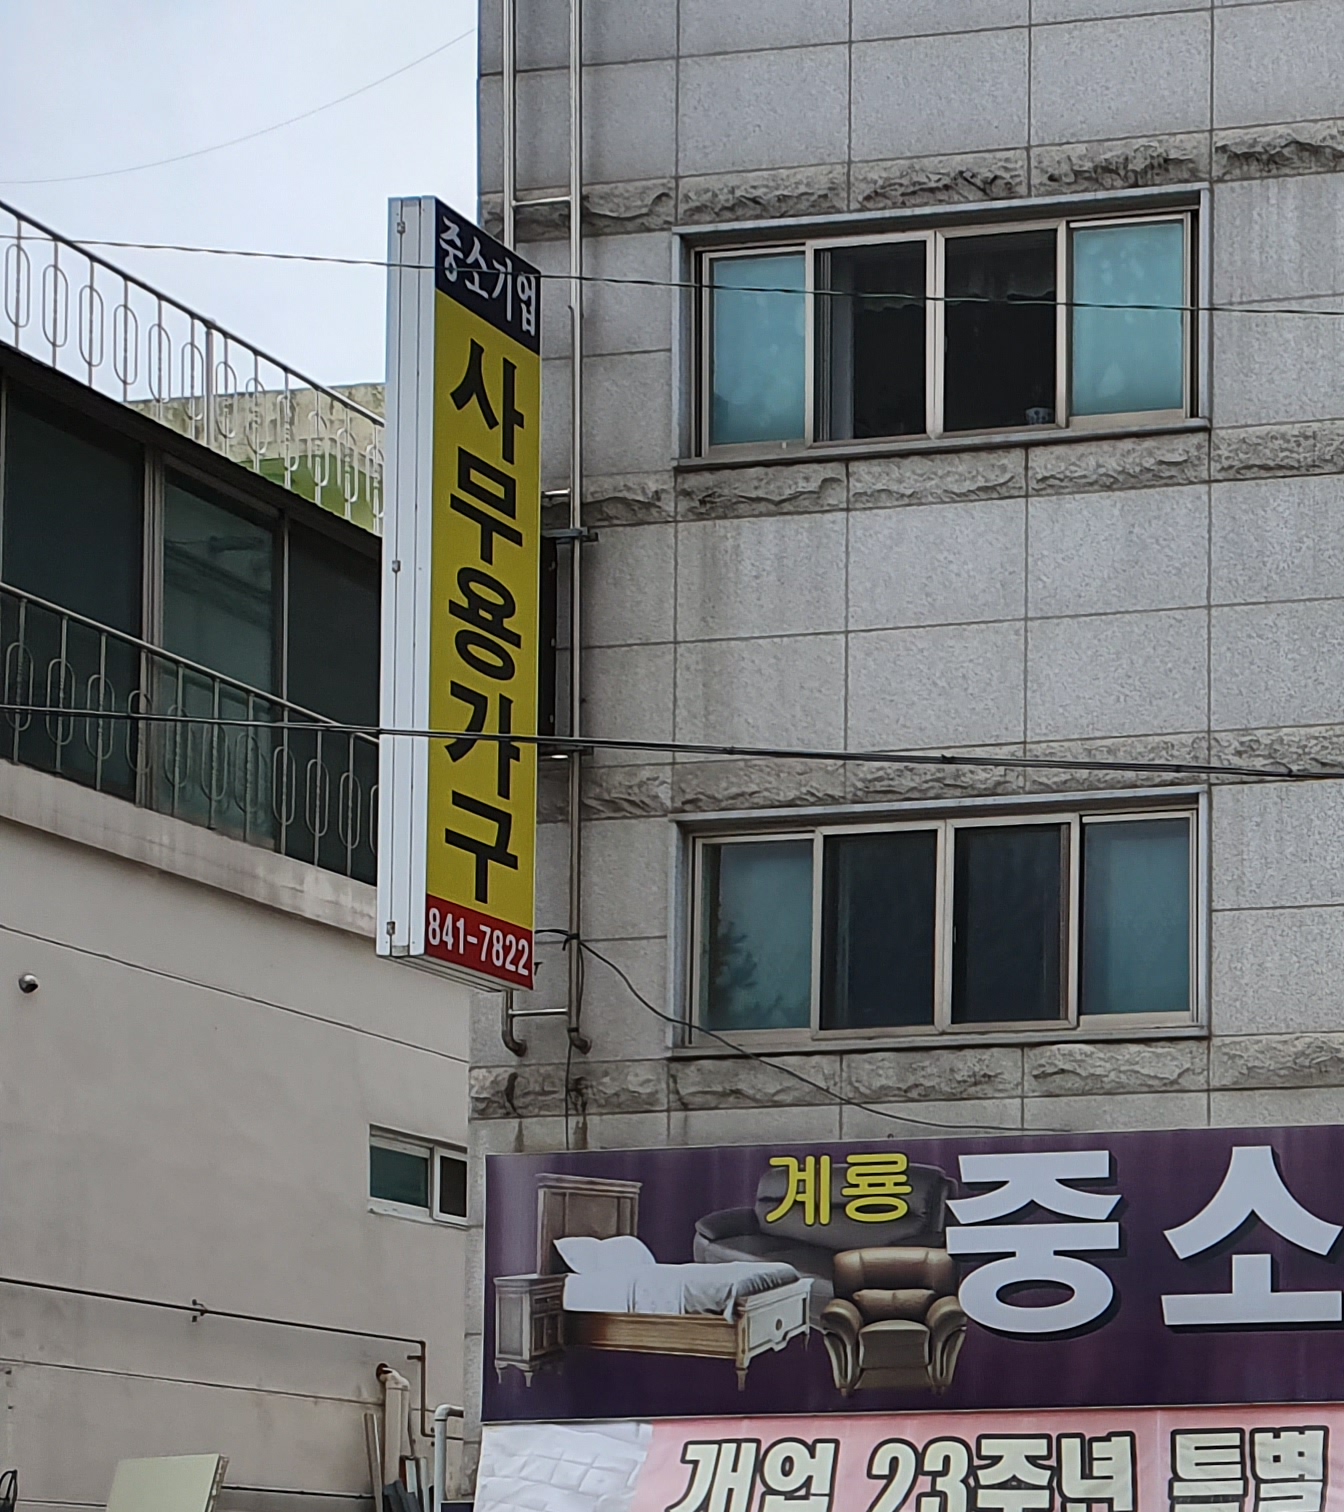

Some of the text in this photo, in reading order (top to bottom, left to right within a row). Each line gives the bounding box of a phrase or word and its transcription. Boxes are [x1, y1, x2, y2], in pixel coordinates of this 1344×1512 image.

[439, 216, 536, 337] 중소기업
[444, 338, 524, 905] 사무용가구
[428, 907, 529, 976] 841-7822
[764, 1152, 913, 1226] 계룡
